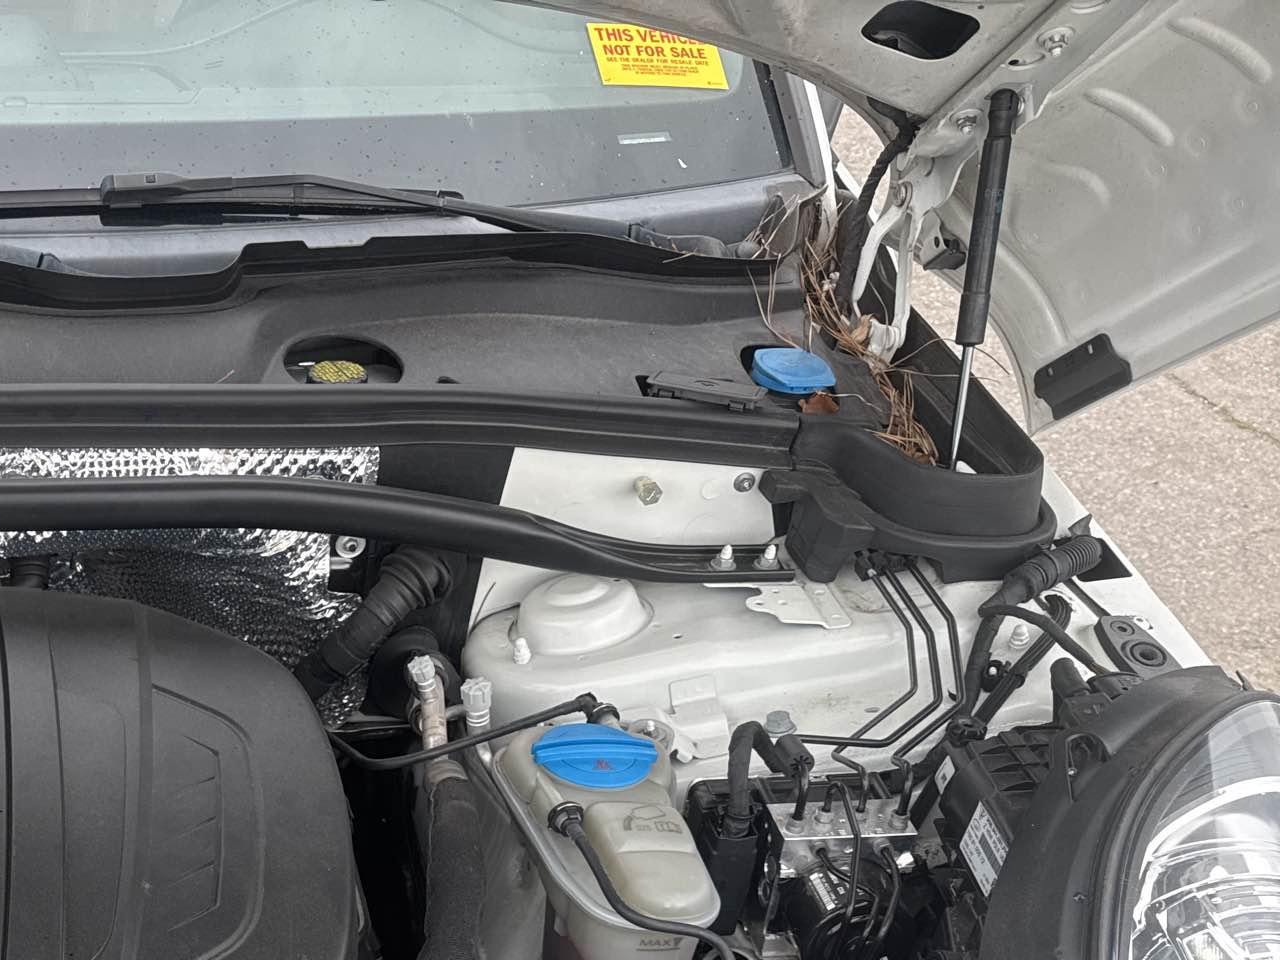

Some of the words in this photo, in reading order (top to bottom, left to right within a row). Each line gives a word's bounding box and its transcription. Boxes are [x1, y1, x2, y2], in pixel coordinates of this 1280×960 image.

[594, 28, 634, 42] THIS
[602, 44, 631, 56] NOT
[636, 45, 666, 57] FOR
[670, 47, 707, 59] SALE
[639, 938, 673, 947] MAX
